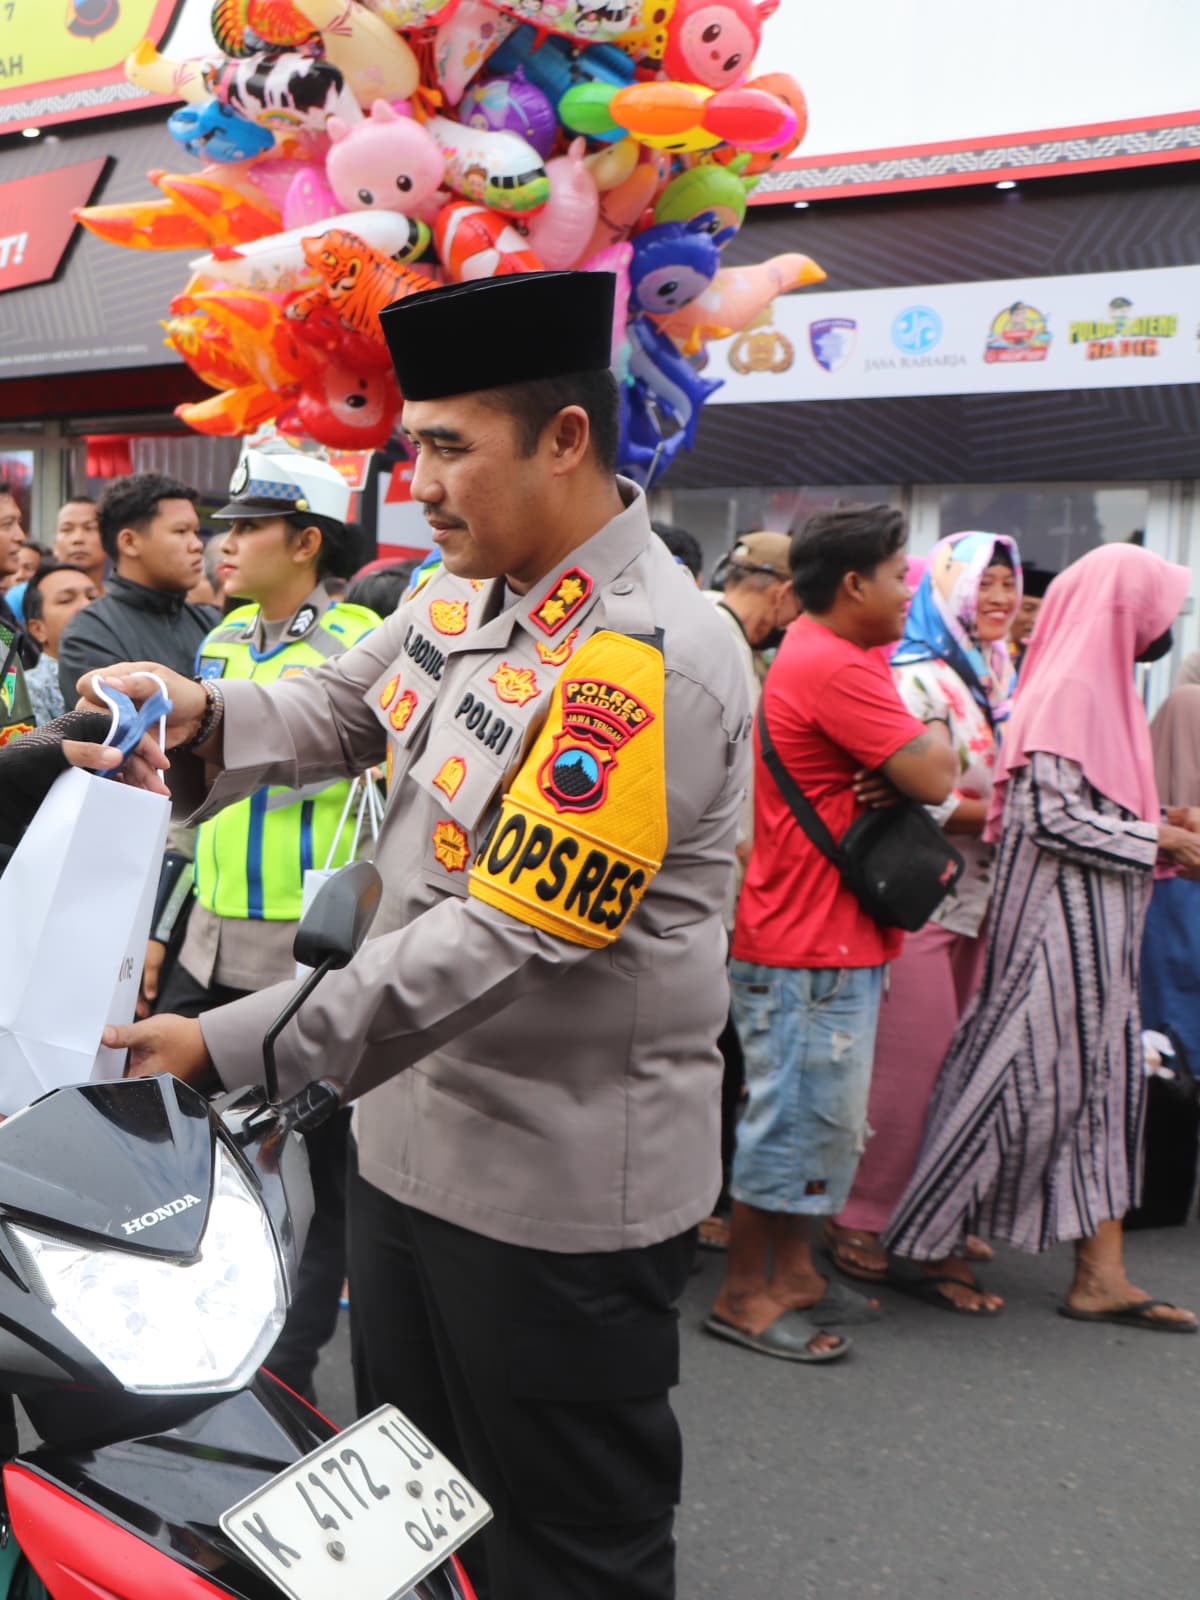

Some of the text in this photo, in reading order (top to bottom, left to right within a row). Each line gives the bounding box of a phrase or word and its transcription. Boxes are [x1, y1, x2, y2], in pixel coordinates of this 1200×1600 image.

[5, 2, 16, 22] 7
[864, 357, 897, 372] JASA
[901, 353, 968, 369] RAHARJA
[567, 683, 648, 723] POLRES
[575, 694, 630, 722] KUDUS
[455, 692, 513, 756] POLRI
[567, 714, 623, 742] JAWA TENGAH
[121, 1194, 202, 1235] HONDA
[241, 1415, 434, 1568] K 4172 IU
